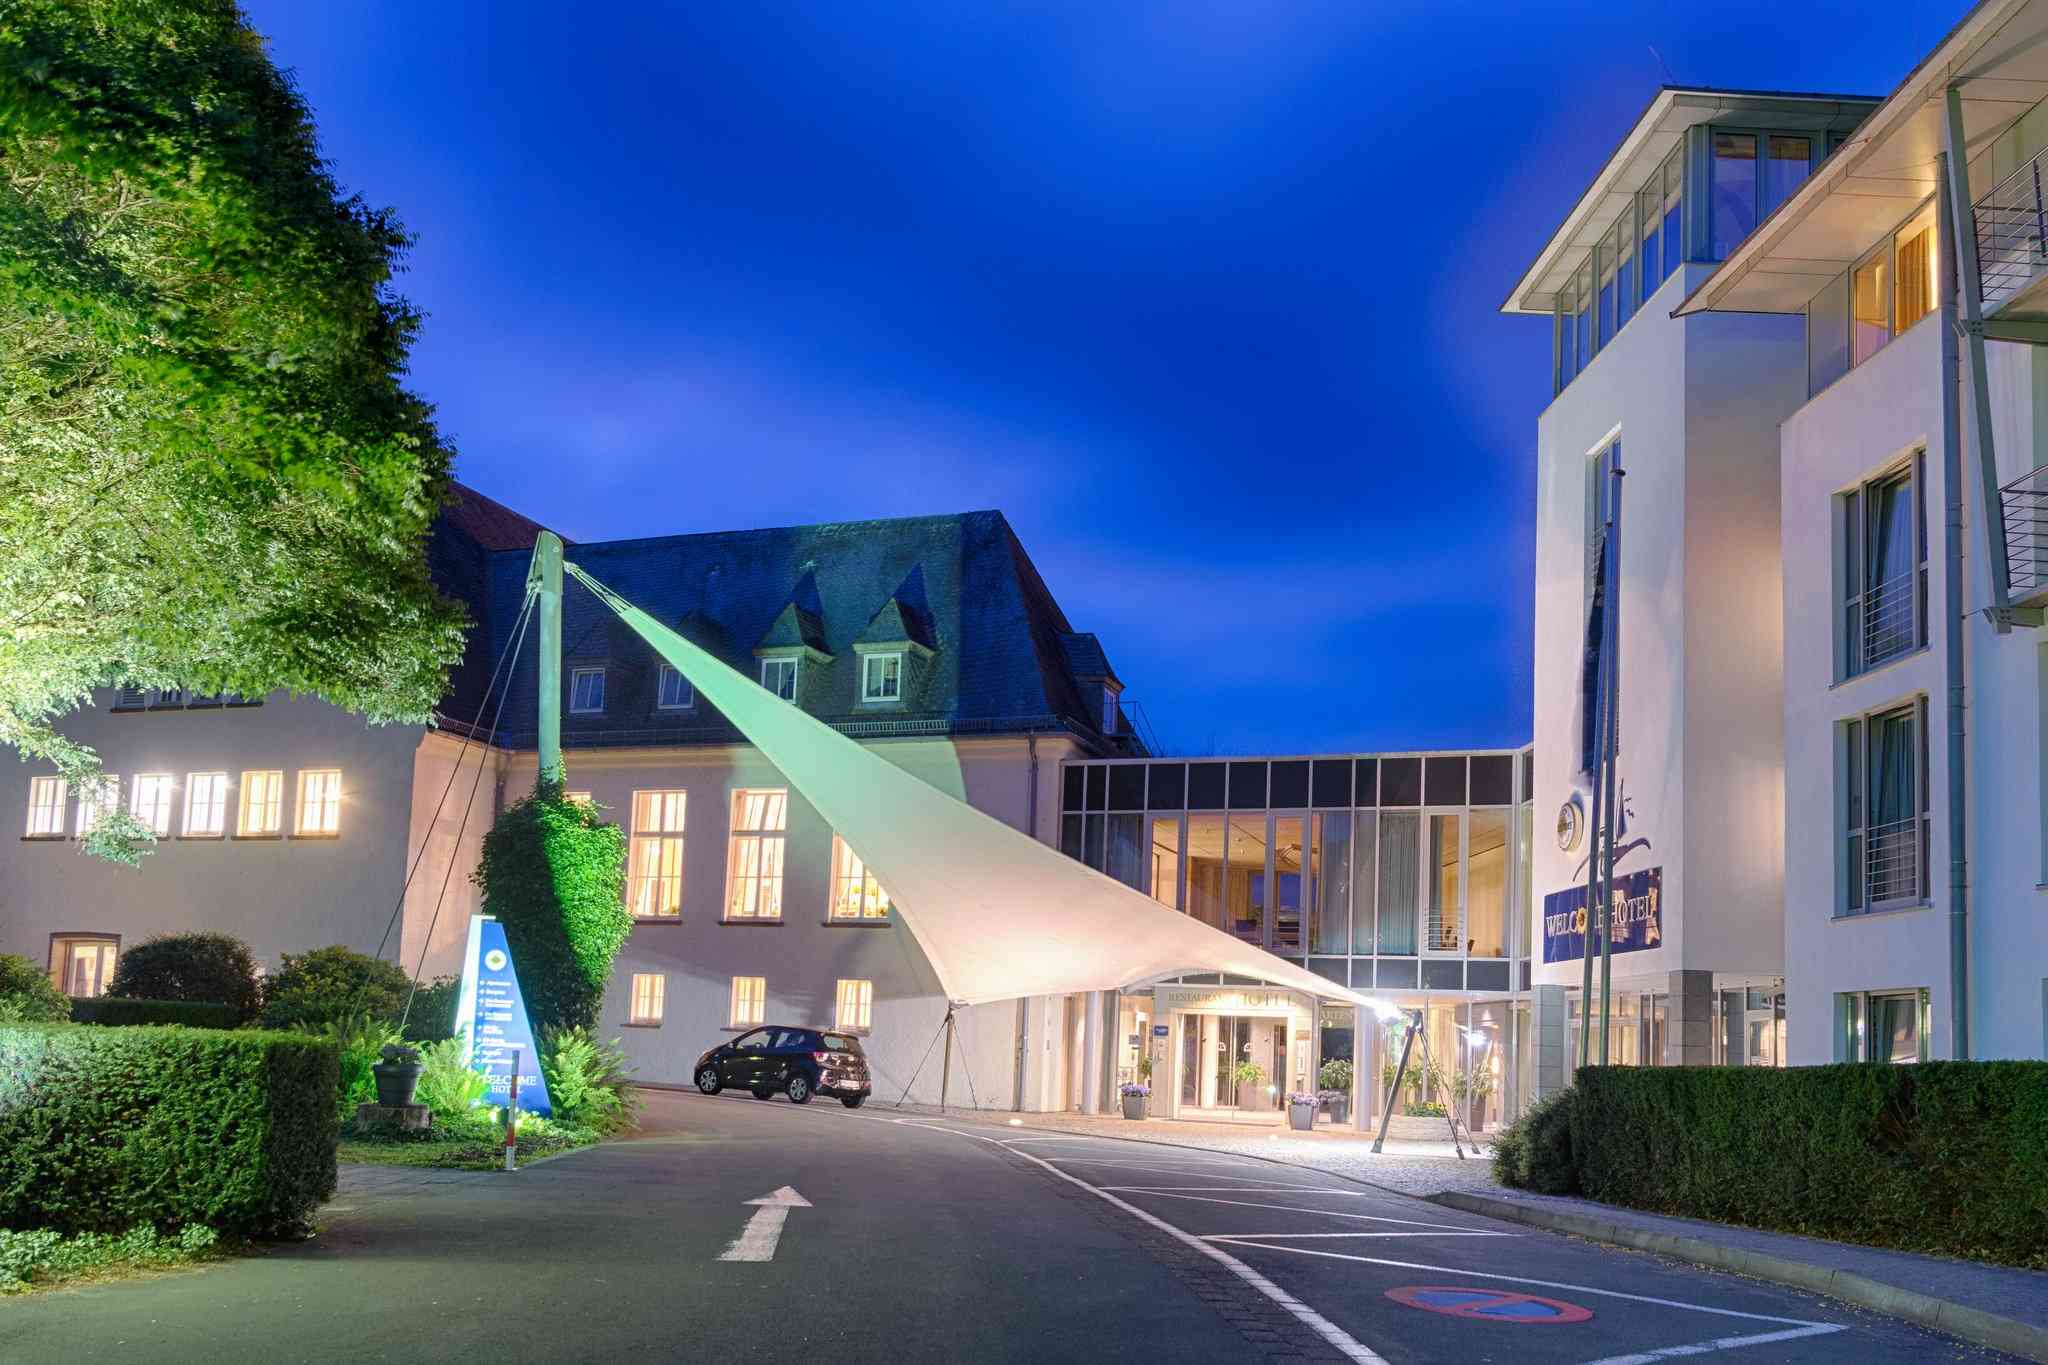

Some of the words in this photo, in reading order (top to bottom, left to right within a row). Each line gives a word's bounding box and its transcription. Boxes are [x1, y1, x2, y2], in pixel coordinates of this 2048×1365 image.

[1545, 904, 1603, 937] WELCOE
[1167, 992, 1226, 1001] RESTAURA
[483, 1075, 537, 1086] ELCME
[492, 1086, 523, 1094] HOTL
